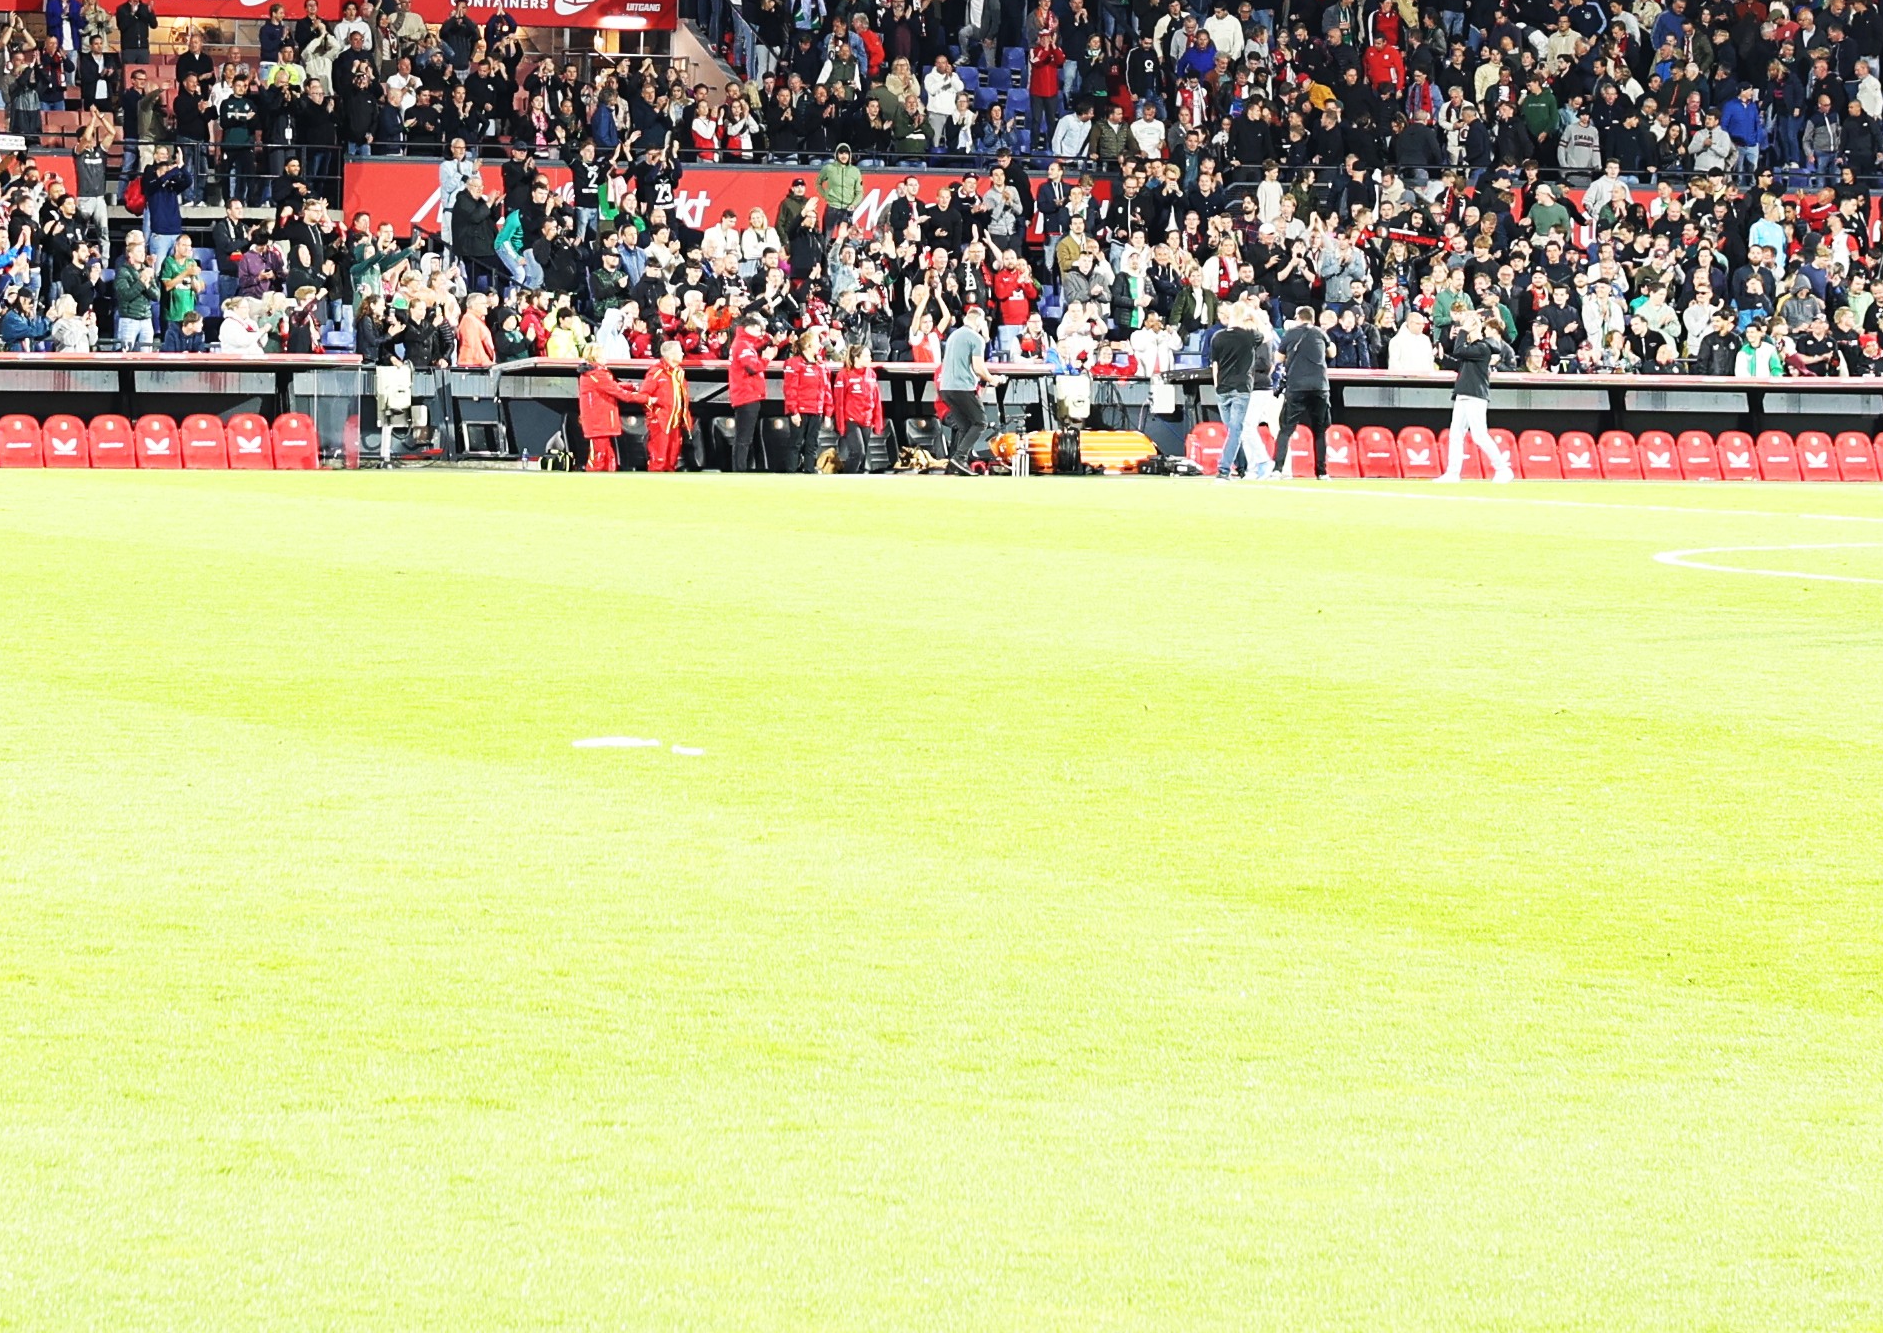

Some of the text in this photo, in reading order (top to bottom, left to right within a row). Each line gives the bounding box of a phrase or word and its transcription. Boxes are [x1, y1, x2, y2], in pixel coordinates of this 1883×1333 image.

[625, 1, 662, 13] UITGANG
[587, 171, 598, 188] 2
[654, 182, 673, 203] 23
